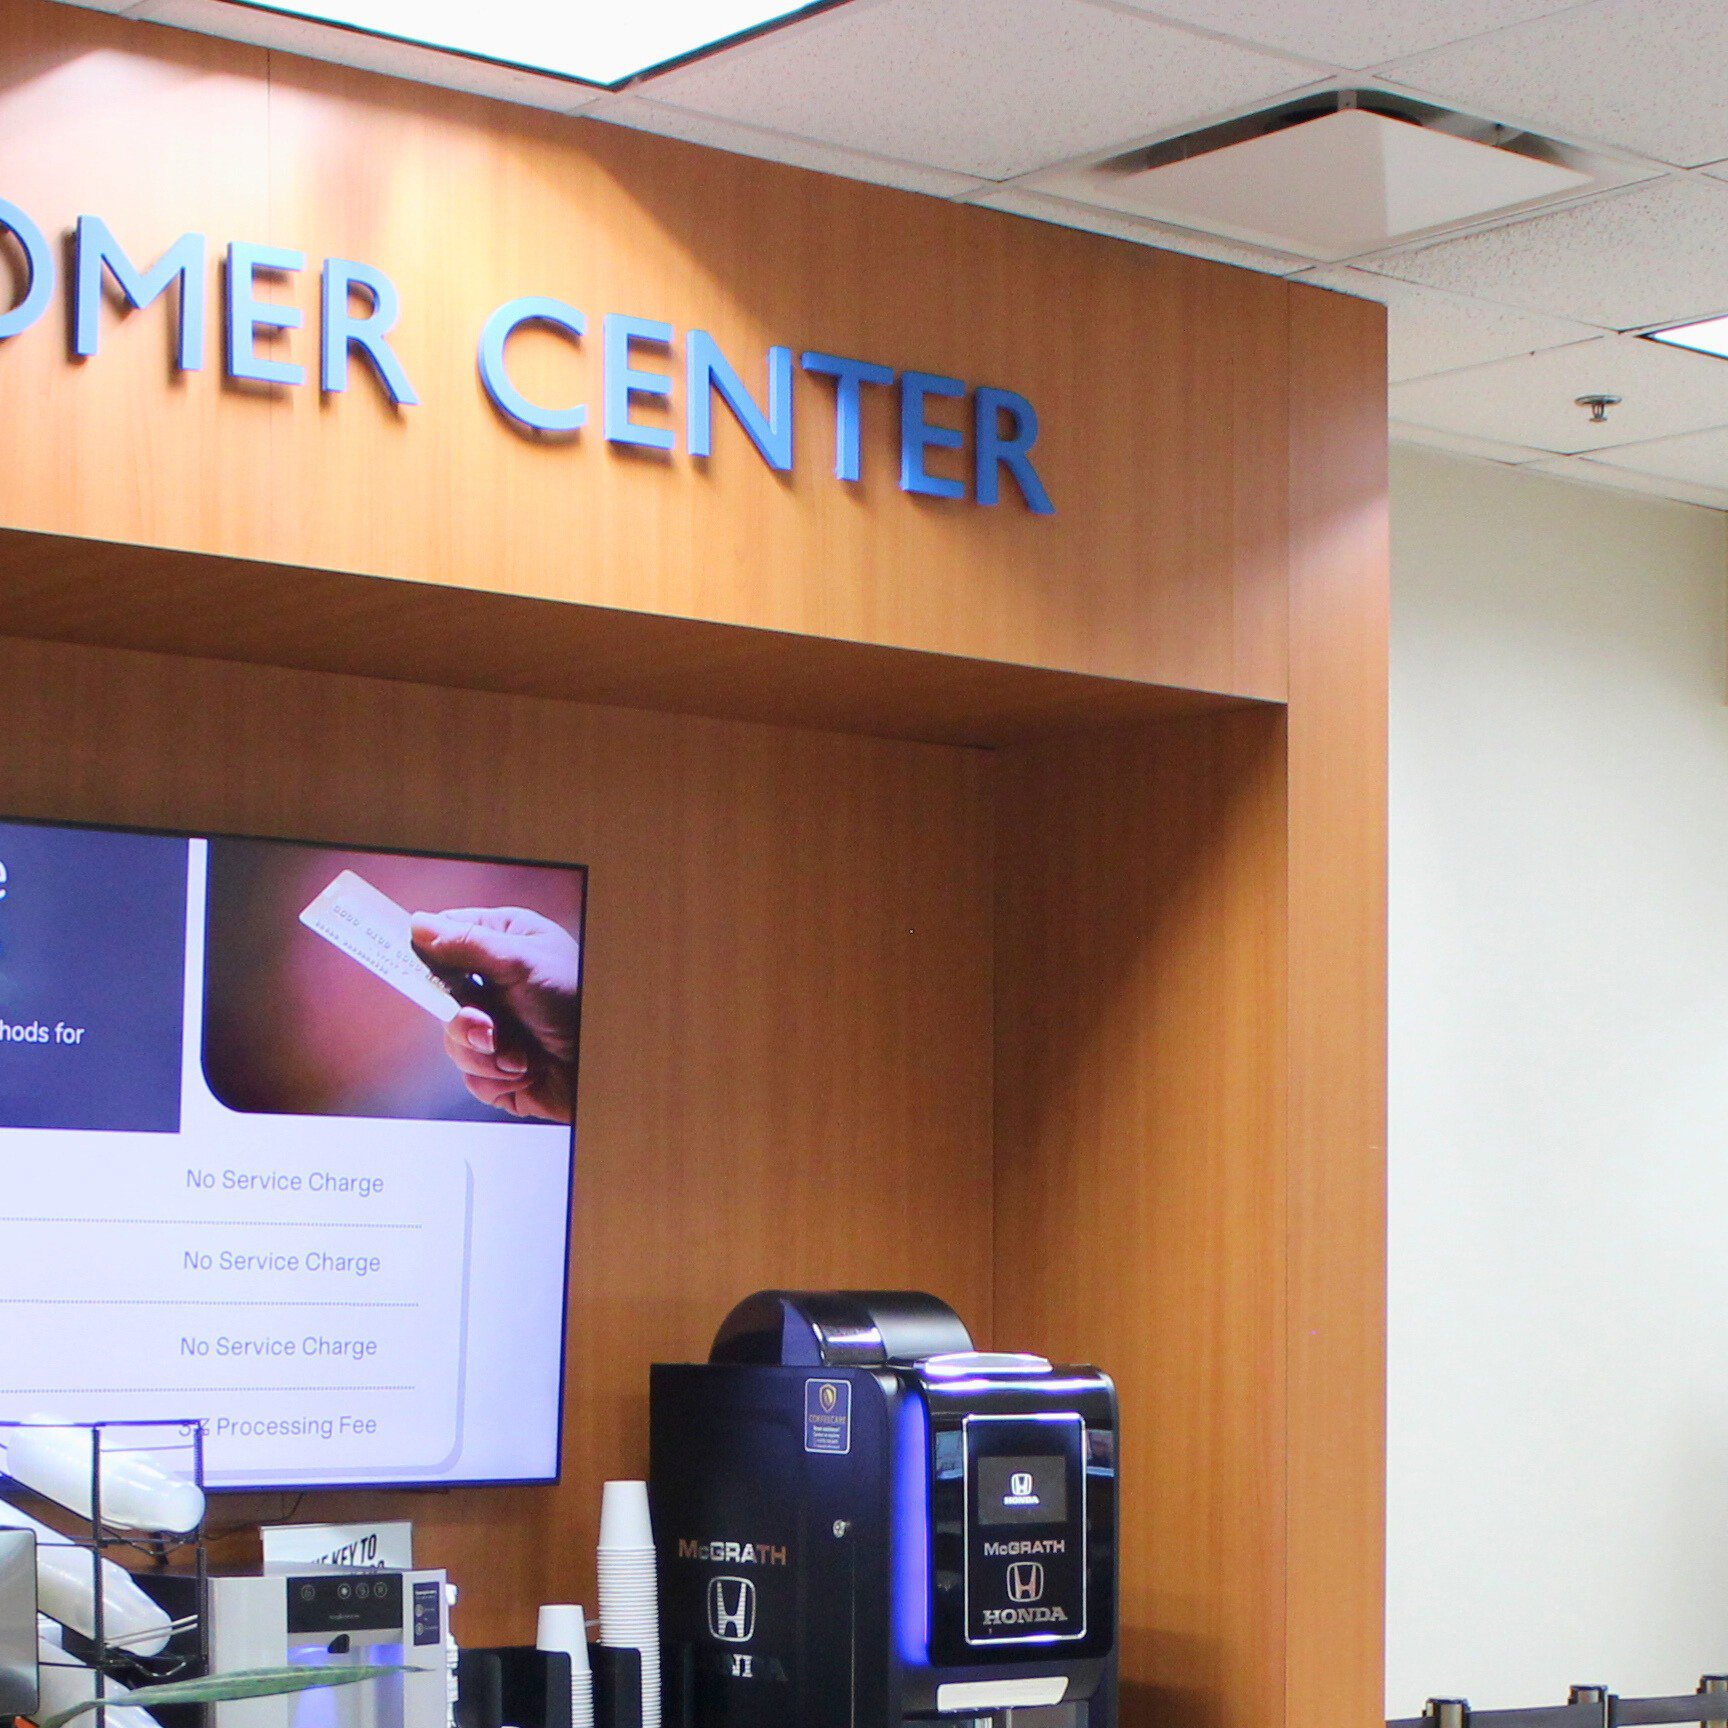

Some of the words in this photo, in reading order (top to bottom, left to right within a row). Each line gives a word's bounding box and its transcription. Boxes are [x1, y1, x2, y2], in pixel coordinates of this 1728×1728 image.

[478, 296, 1055, 515] CENTER
[54, 1022, 85, 1044] for
[186, 1169, 215, 1189] No
[222, 1170, 302, 1190] Service
[308, 1172, 384, 1197] Charge
[183, 1251, 212, 1270] No
[219, 1251, 299, 1271] Service
[305, 1252, 381, 1277] Charge
[181, 1337, 210, 1356] No
[216, 1336, 296, 1356] Service
[302, 1336, 377, 1360] Charge
[217, 1417, 332, 1439] Processing
[339, 1416, 377, 1434] Fee
[362, 1534, 377, 1563] TO
[678, 1538, 787, 1566] McGRATH
[984, 1540, 1065, 1556] McGRATH
[983, 1606, 1068, 1625] HONDA
